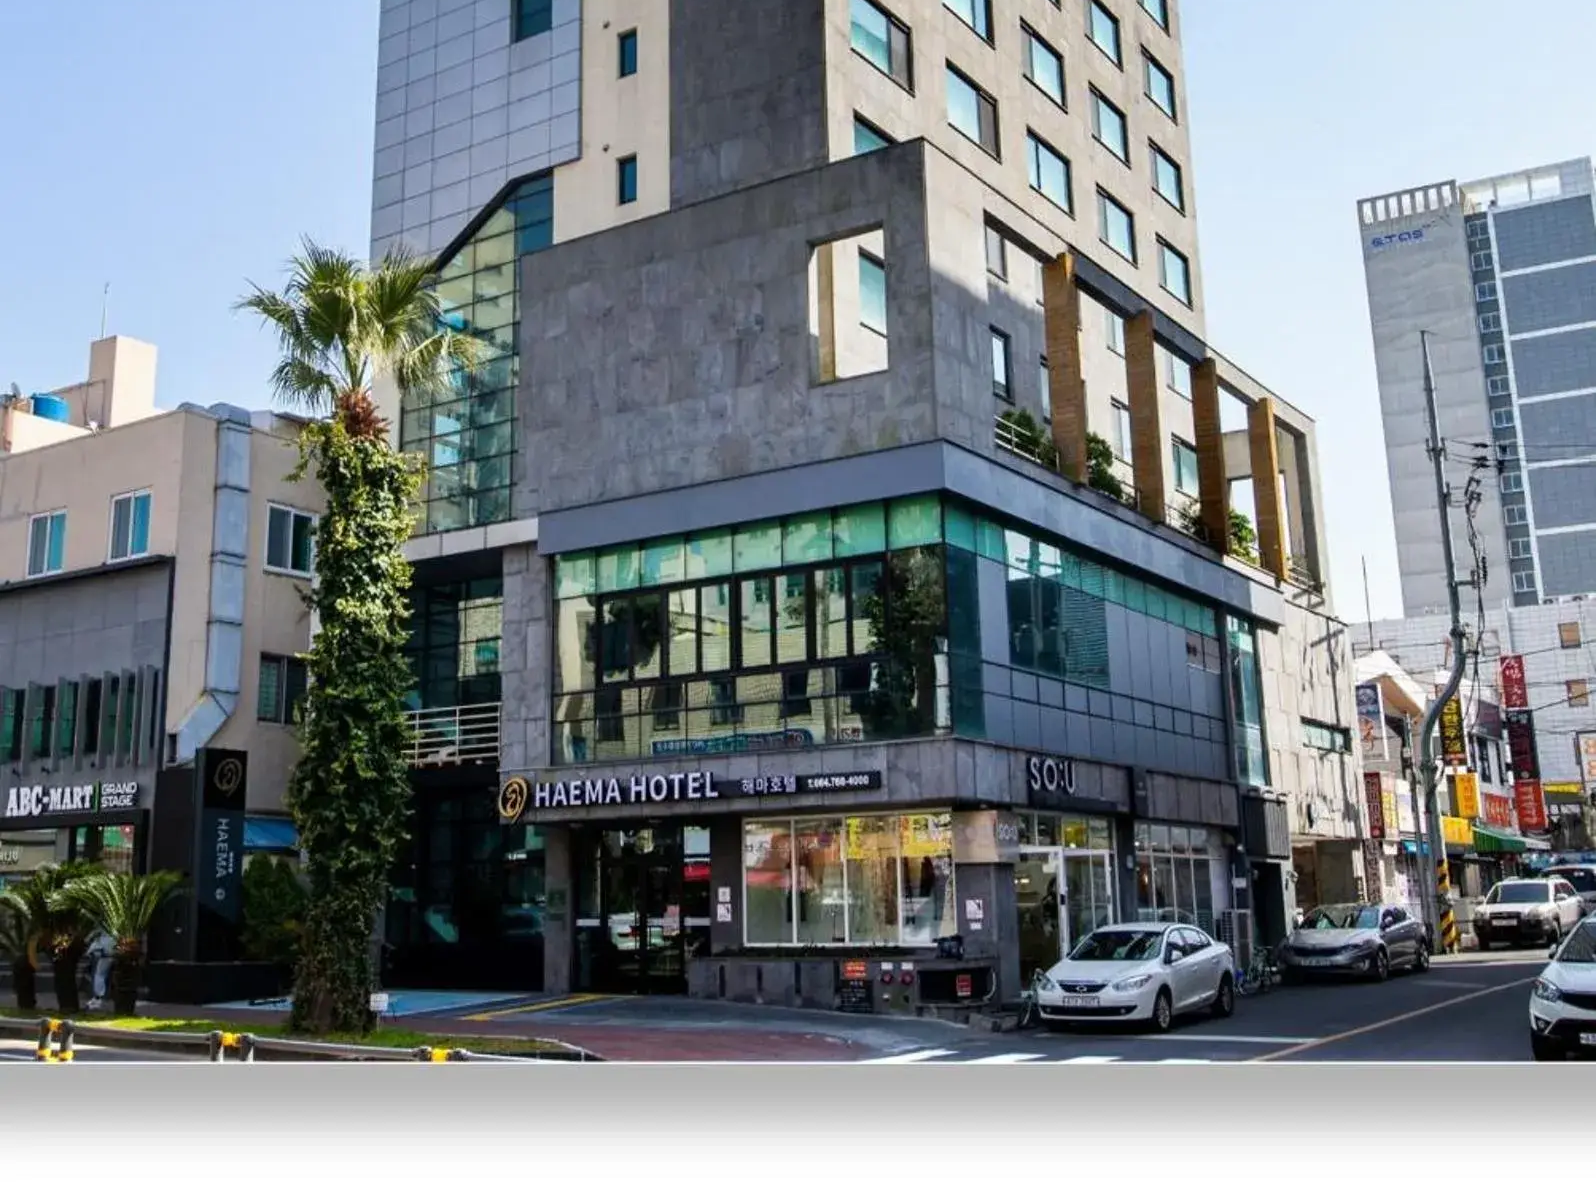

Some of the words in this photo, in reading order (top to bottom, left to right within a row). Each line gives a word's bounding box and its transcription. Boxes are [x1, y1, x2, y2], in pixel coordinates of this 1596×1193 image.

[101, 782, 137, 795] GRAND
[535, 780, 621, 807] HAEMA
[630, 771, 719, 802] HOTEL
[741, 776, 796, 795] 해마호텔
[1030, 757, 1075, 794] SO:U
[6, 785, 93, 817] ABC-MART
[101, 794, 133, 807] STAGE
[215, 818, 230, 878] HAEMA
